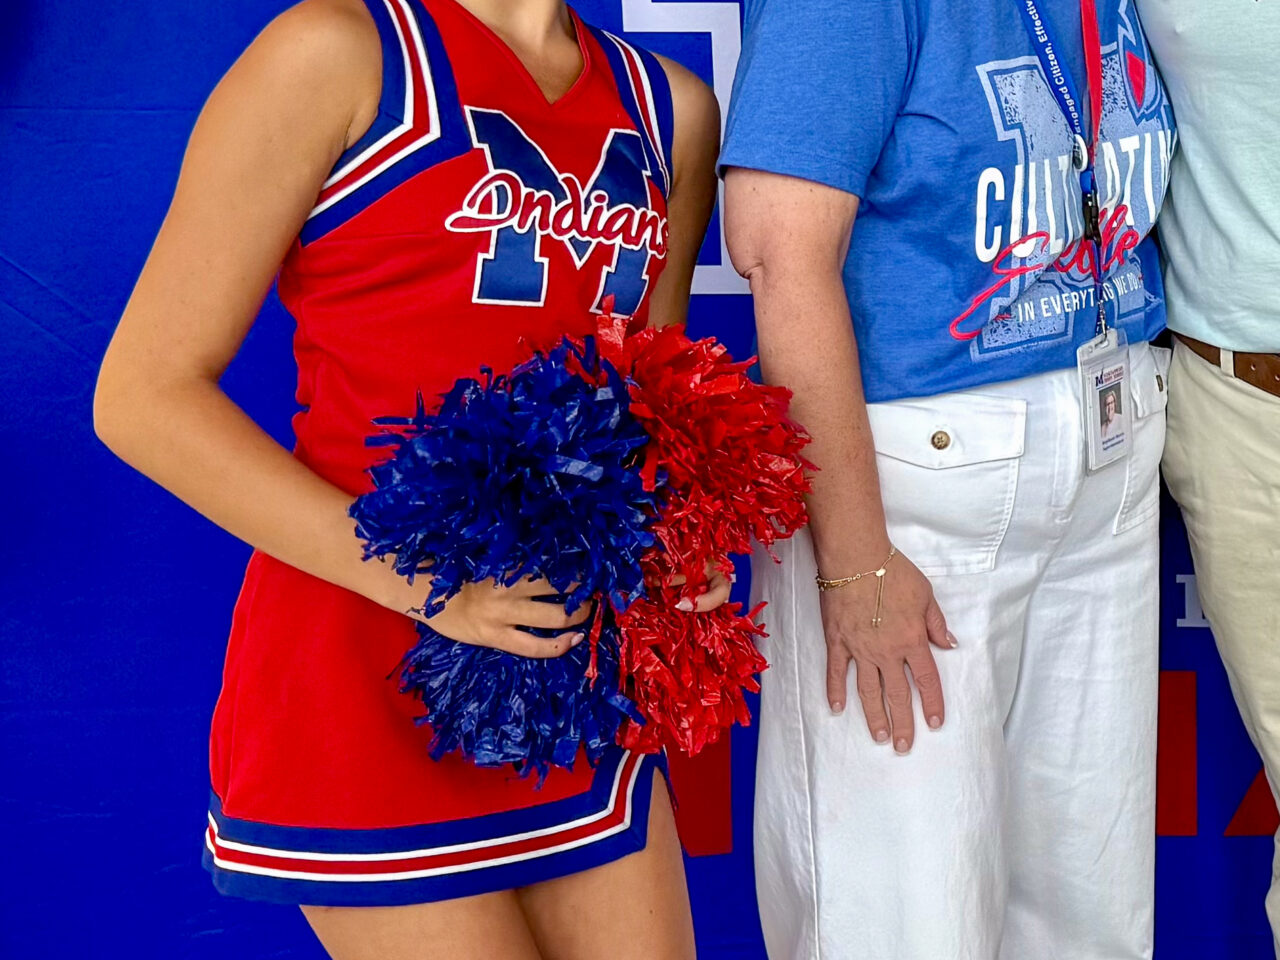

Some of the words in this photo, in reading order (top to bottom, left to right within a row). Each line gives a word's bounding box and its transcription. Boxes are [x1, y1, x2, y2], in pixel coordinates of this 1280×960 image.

[1045, 42, 1065, 86] Citizen,
[463, 105, 652, 319] M
[1017, 301, 1036, 323] IN
[1040, 282, 1116, 318] EVERYTNG
[1112, 274, 1129, 297] WE
